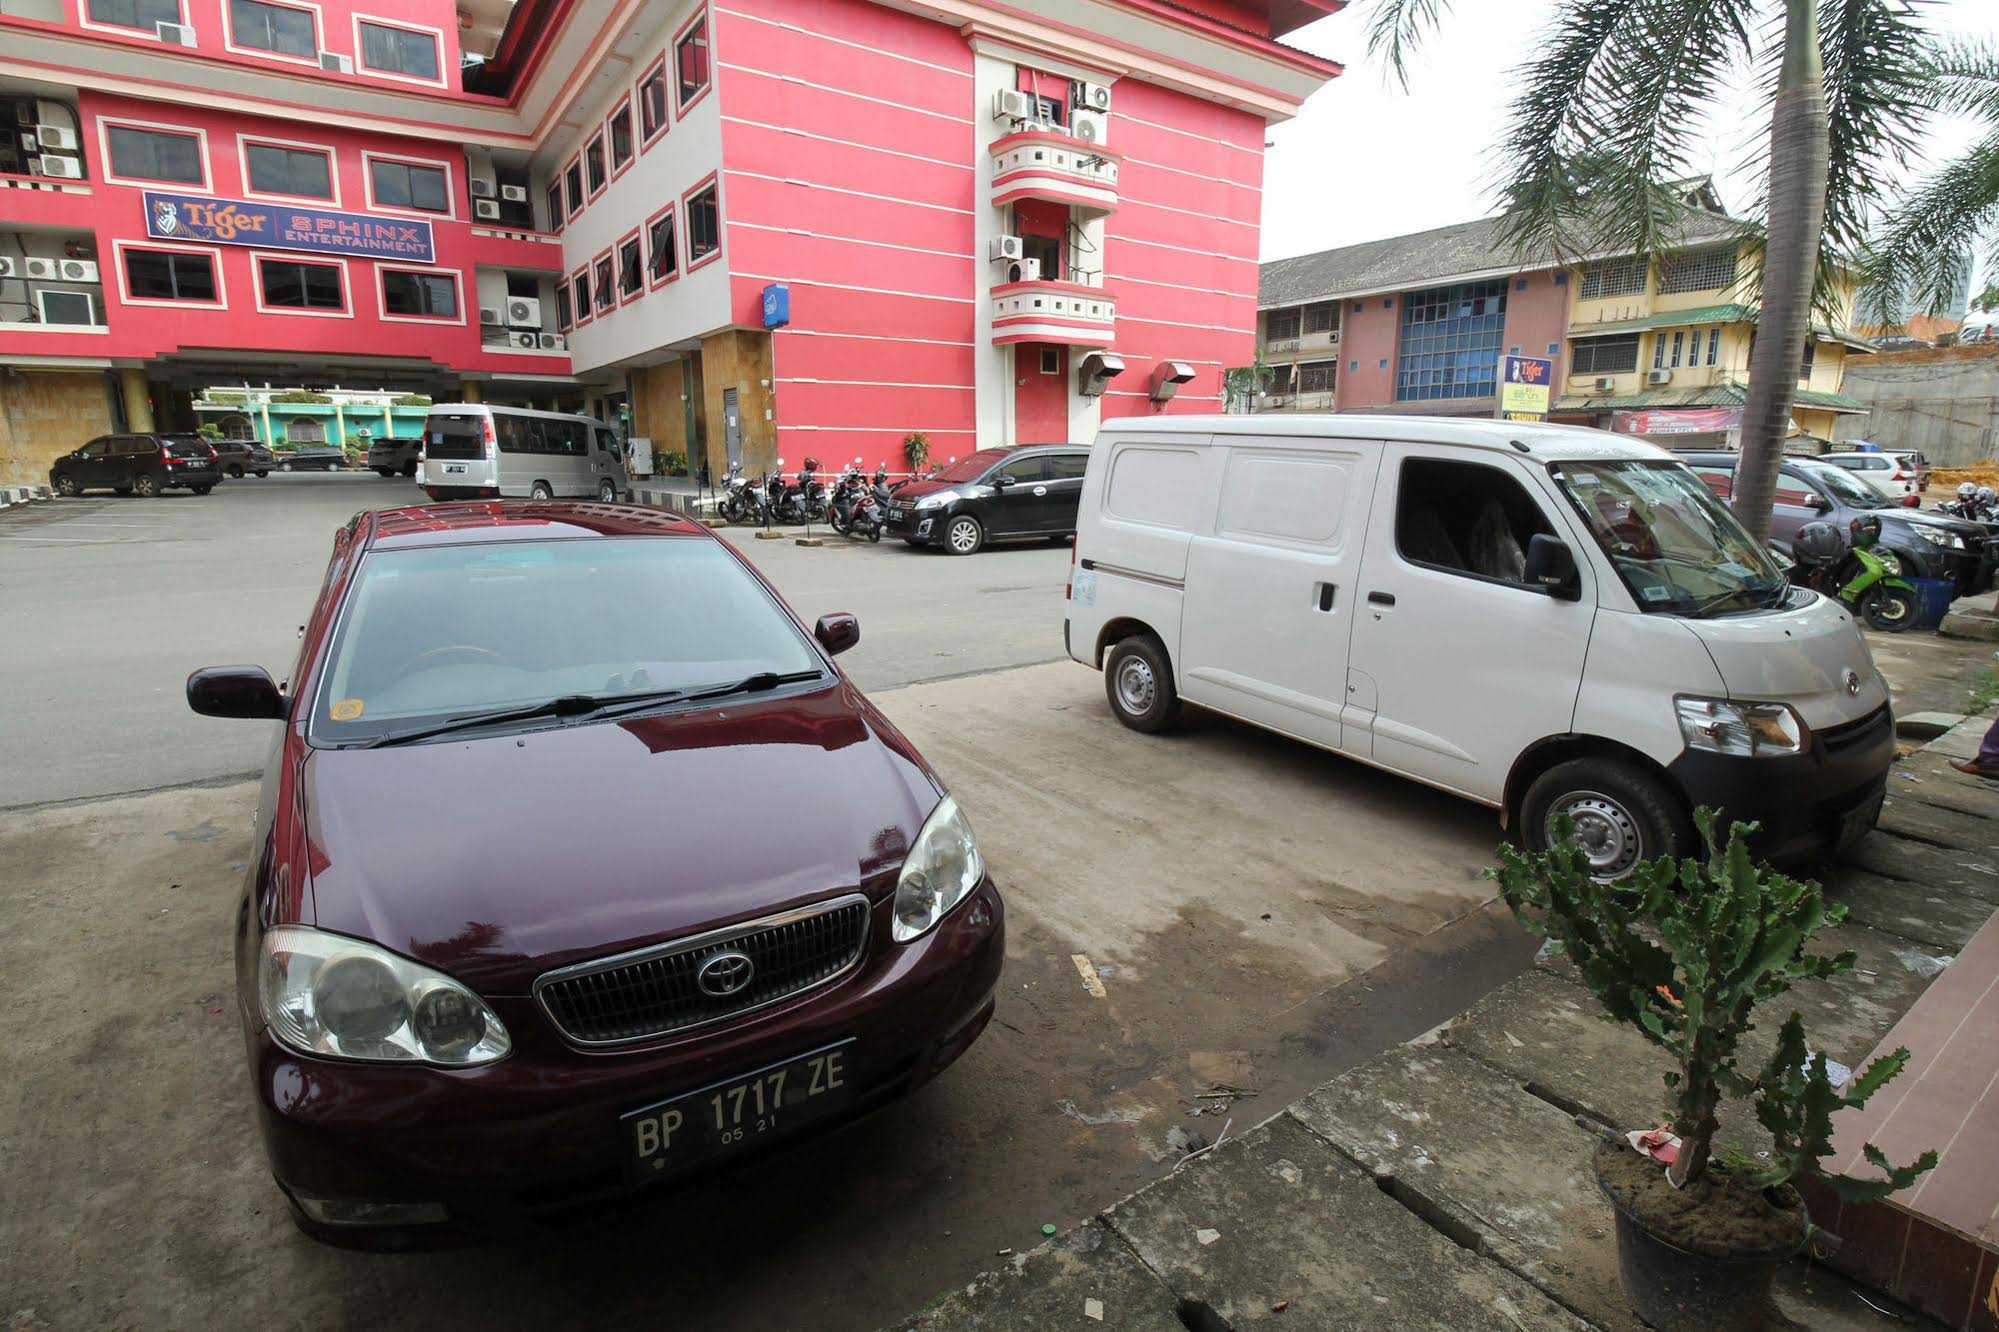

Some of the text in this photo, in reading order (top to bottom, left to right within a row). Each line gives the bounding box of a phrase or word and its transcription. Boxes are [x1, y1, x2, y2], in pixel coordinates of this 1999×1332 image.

[183, 202, 267, 239] Tiger
[291, 215, 420, 243] SPHINX
[285, 230, 427, 254] ENTERTAINMENT
[1521, 361, 1543, 381] Tiger
[636, 1051, 844, 1158] BP 1717 ZE
[721, 1115, 777, 1145] 05 21
